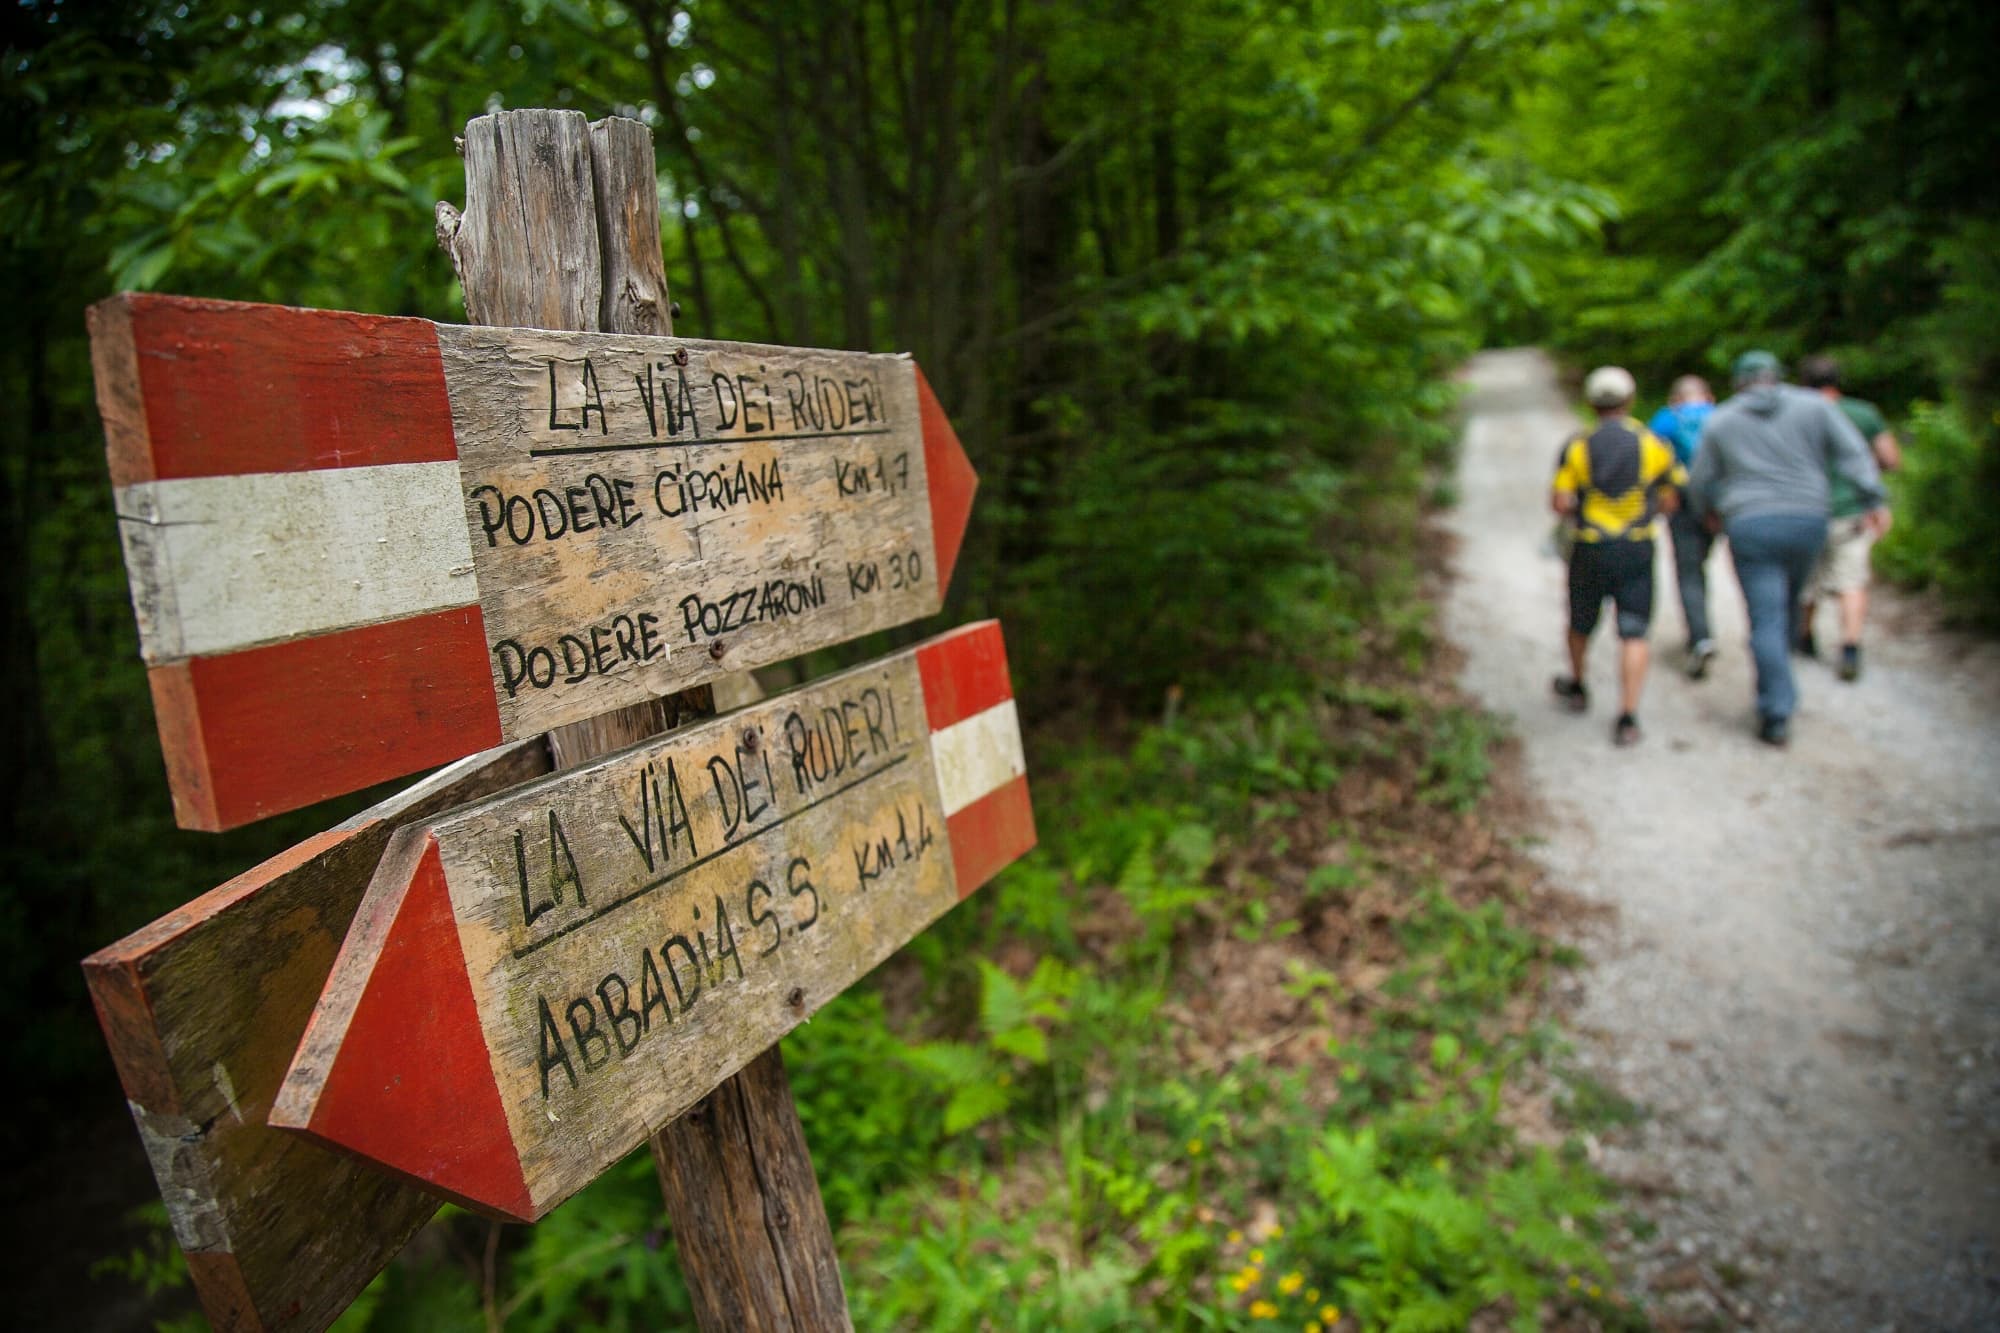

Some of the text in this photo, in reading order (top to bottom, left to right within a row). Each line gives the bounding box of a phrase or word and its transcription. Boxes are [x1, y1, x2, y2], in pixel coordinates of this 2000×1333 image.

[549, 358, 608, 435] LA
[471, 473, 643, 547] PODERE
[833, 451, 909, 498] KM 1,7
[847, 551, 922, 600] KM 3,0
[493, 613, 664, 698] PODERE
[513, 809, 588, 927] LA
[853, 835, 895, 892] KM
